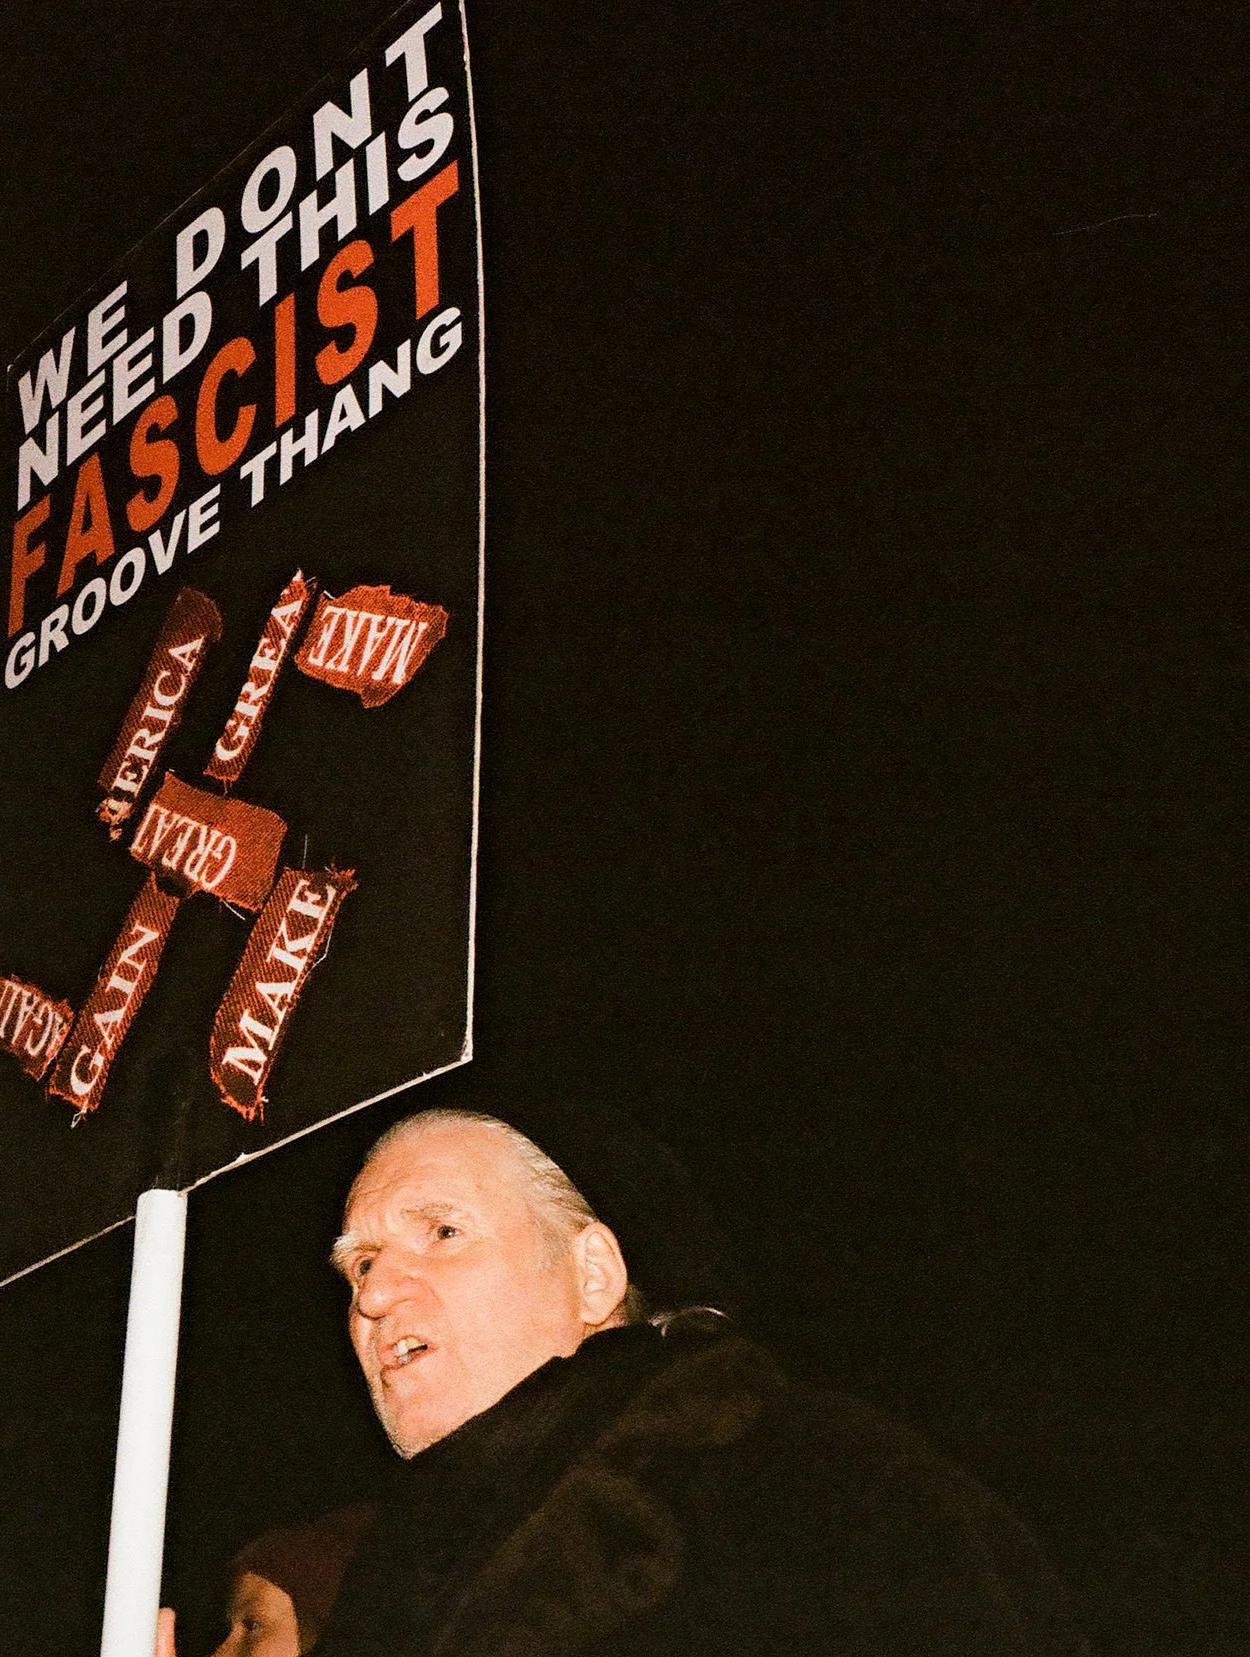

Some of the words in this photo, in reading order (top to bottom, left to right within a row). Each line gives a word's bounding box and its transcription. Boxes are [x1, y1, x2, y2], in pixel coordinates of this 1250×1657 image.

[8, 160, 460, 638] FASCIST
[16, 291, 213, 511] NEED
[240, 87, 455, 307] THIS
[17, 280, 128, 434] WE
[176, 2, 443, 300] DONT
[4, 484, 222, 690] GROOVE
[239, 307, 464, 508] THANG
[308, 604, 428, 684] MAKE
[69, 922, 160, 1097] GAIN
[221, 879, 337, 1086] MAKE
